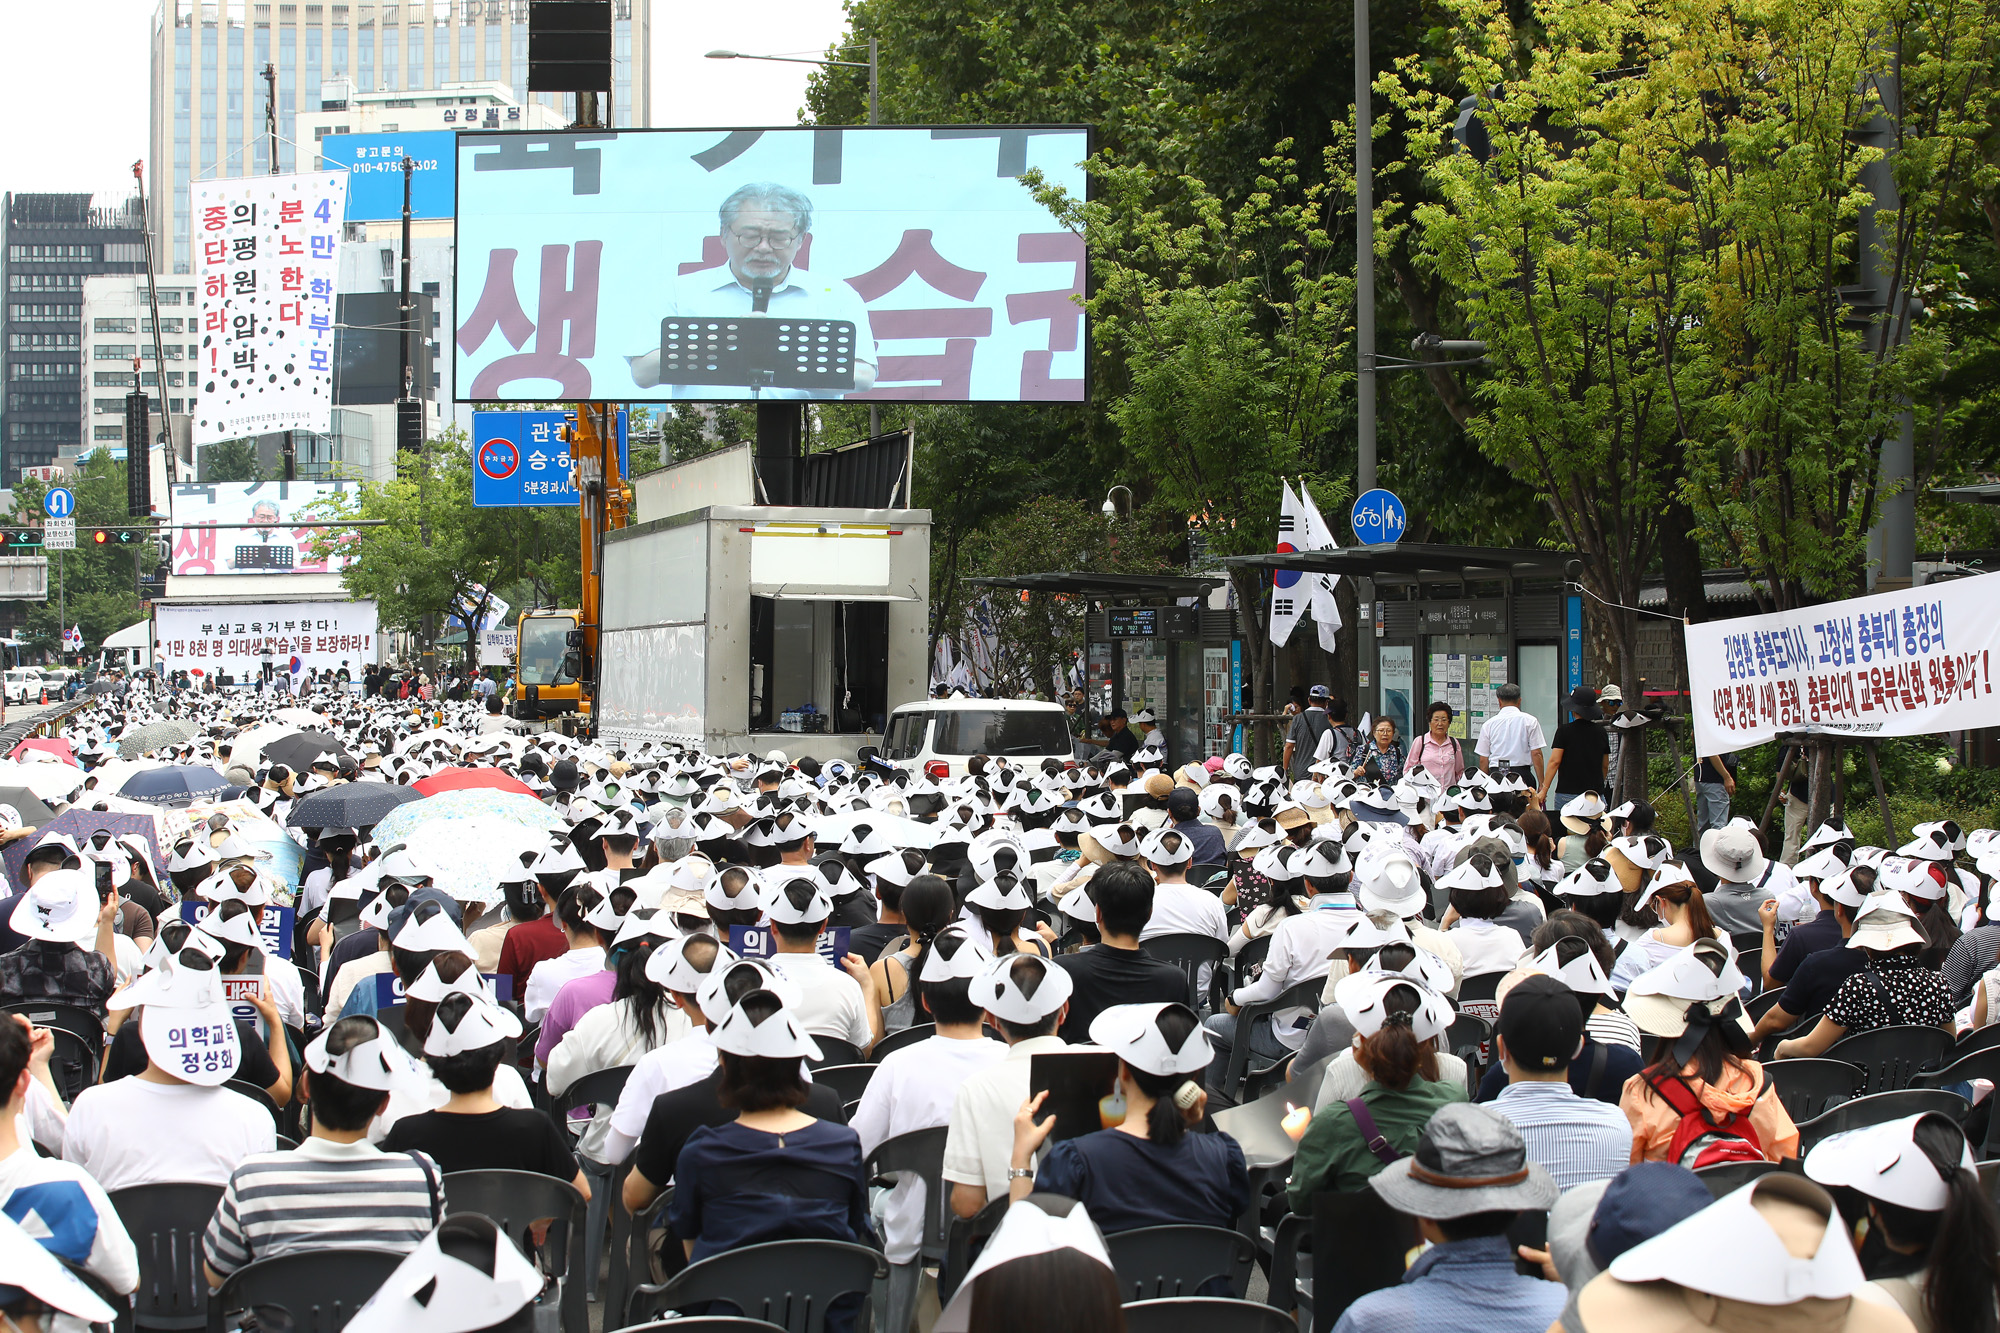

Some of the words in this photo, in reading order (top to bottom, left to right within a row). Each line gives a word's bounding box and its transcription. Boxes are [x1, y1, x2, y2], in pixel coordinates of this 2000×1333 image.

[443, 107, 521, 122] 삼정빌딩
[356, 145, 404, 158] 광고문의
[232, 202, 257, 296] 의평원
[310, 198, 335, 260] 4만
[202, 205, 229, 374] 중단하라!
[278, 199, 305, 326] 분노한다
[232, 313, 259, 374] 압박
[308, 278, 333, 372] 학부모
[484, 455, 514, 463] 주차금지
[524, 480, 569, 495] 5분경과시
[167, 639, 185, 657] 1만
[189, 639, 208, 657] 8천
[212, 639, 223, 657] 명
[315, 634, 370, 653] 보장하라!
[1723, 630, 1755, 680] 김영환
[1753, 624, 1815, 676] 충북도지사,
[1814, 616, 1856, 667] 고창섭
[1858, 608, 1899, 662] 충북대
[1903, 600, 1945, 656] 총장의
[1713, 684, 1736, 730] 49명
[1736, 683, 1757, 729] 정원
[1760, 681, 1777, 725] 4배
[1777, 678, 1807, 726] 증원,
[1808, 671, 1860, 722] 충북의대
[1857, 660, 1928, 714] 교육부실화
[168, 1023, 234, 1048] 의학교육
[181, 1050, 233, 1074] 정상화
